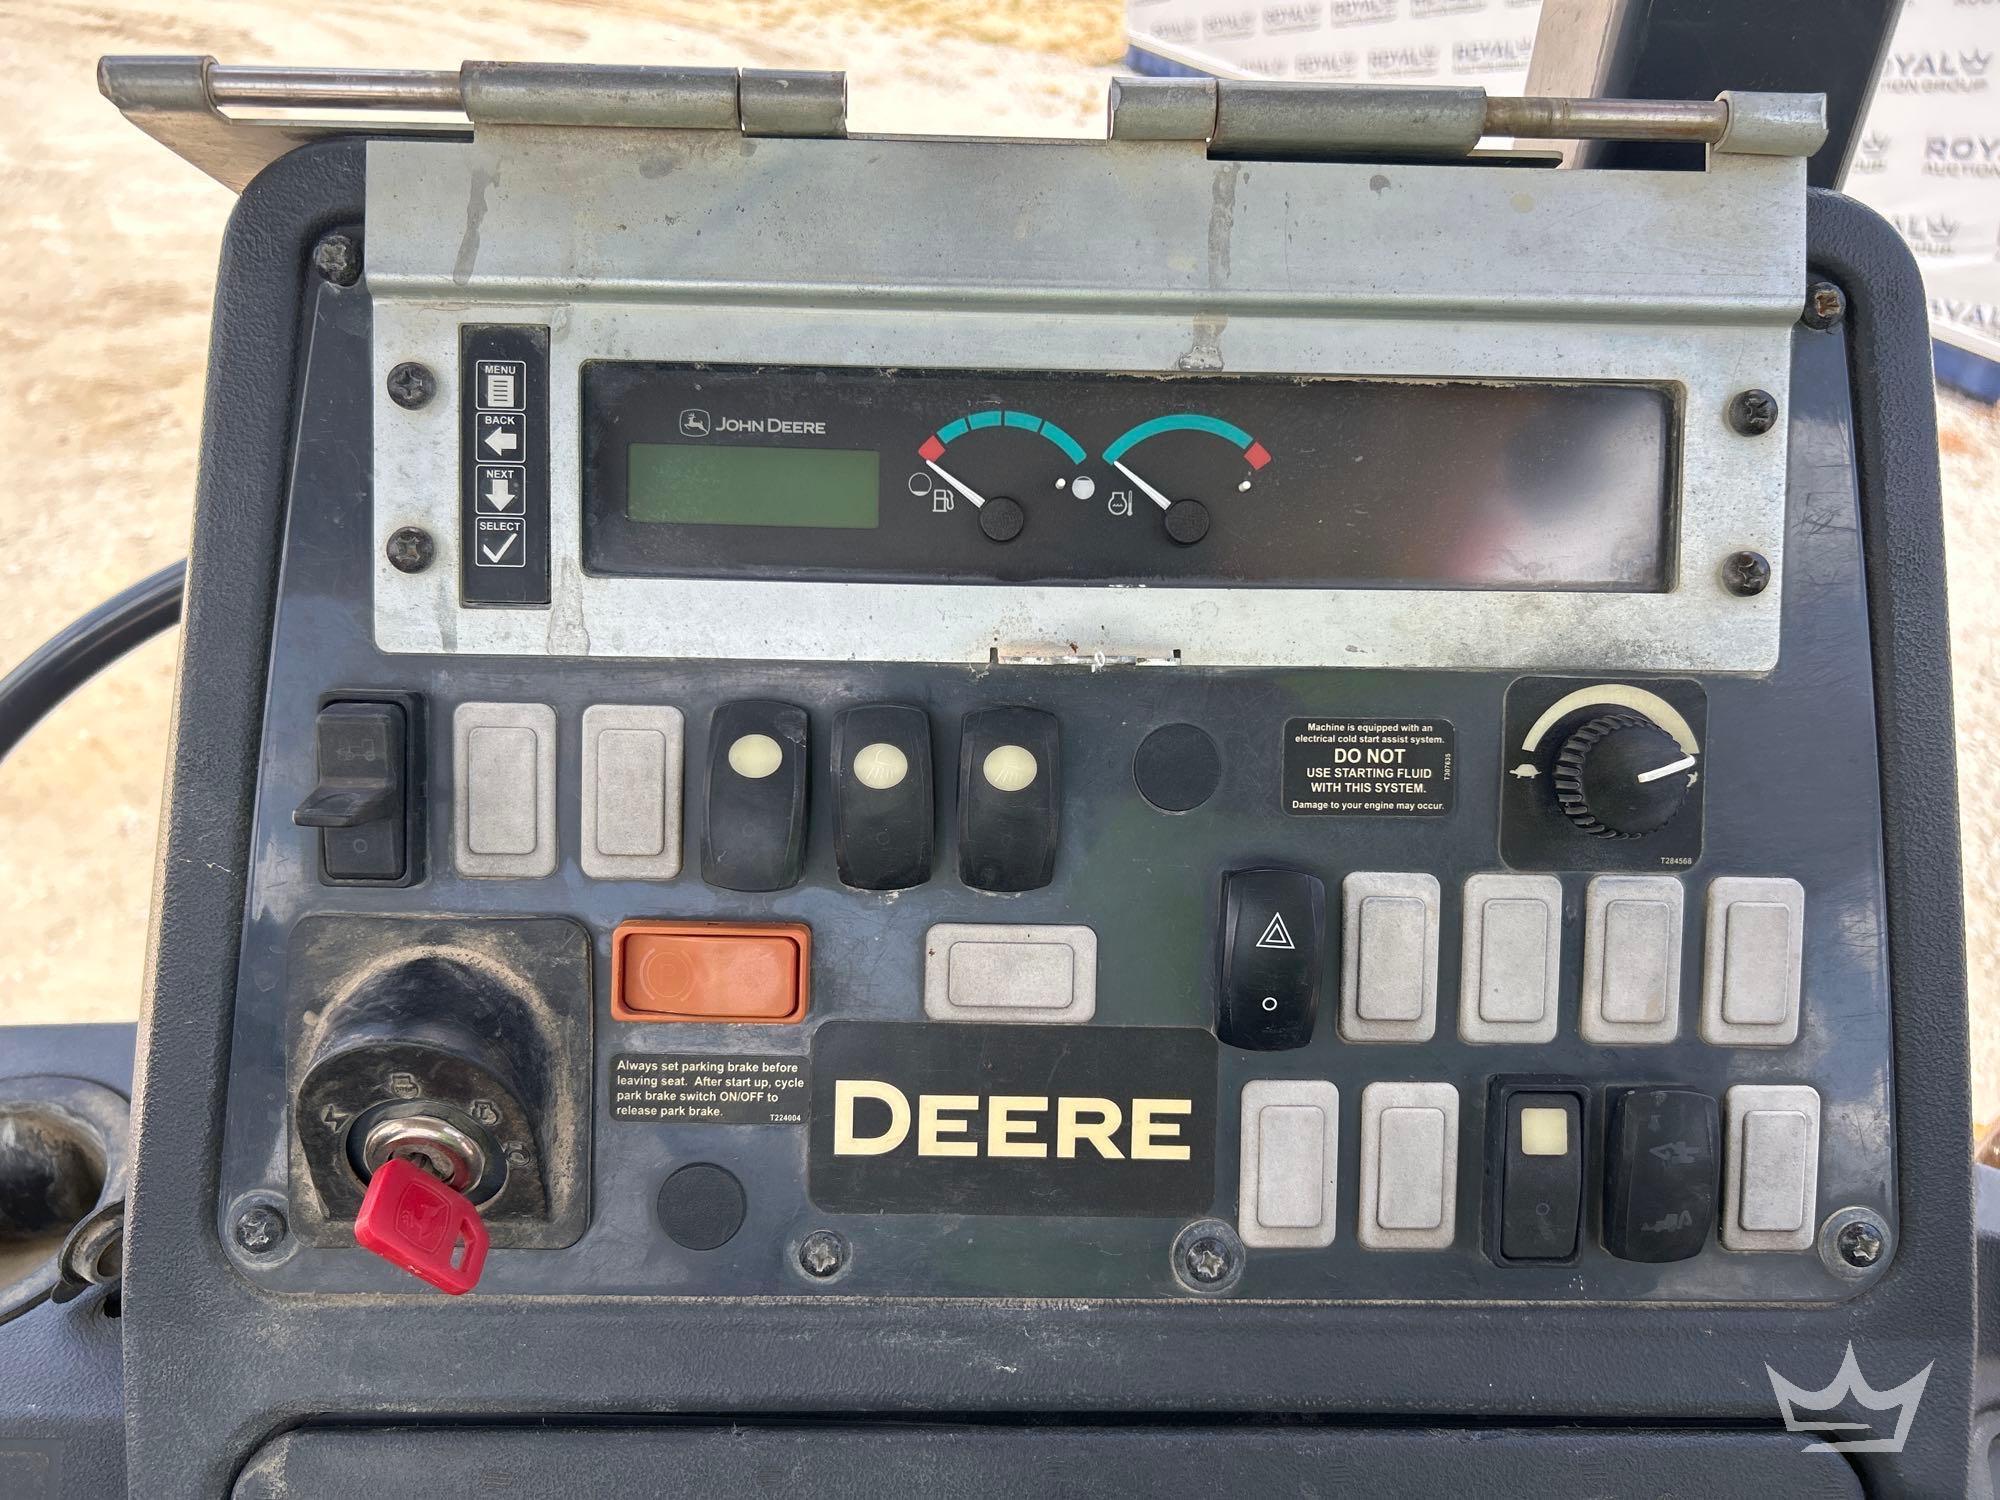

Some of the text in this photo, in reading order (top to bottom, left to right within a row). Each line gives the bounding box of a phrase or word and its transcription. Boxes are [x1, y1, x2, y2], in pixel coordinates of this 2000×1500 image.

[485, 366, 515, 374] MENU
[485, 416, 515, 424] BACK
[716, 417, 826, 434] JOHN DEERE
[487, 470, 514, 478] NEXT
[480, 522, 520, 530] SELECT
[1308, 723, 1344, 731] Machine
[1358, 724, 1398, 733] equipped
[1401, 724, 1419, 732] with
[1411, 737, 1444, 745] system.
[1334, 749, 1406, 763] DO NOT
[1307, 768, 1431, 778] USE STARTING FLUID
[1311, 782, 1426, 793] WITH THIS SYSTEM.
[1292, 801, 1328, 810] Damage
[1342, 802, 1362, 810] your
[1364, 802, 1393, 811] engine
[617, 1061, 798, 1073] Always set parking brake before
[617, 1076, 804, 1089] leaving seat. After start up, cycle
[617, 1092, 778, 1102] park brake switch ON/OFF to
[617, 1106, 723, 1117] release park brake.
[834, 1080, 1192, 1160] DEERE
